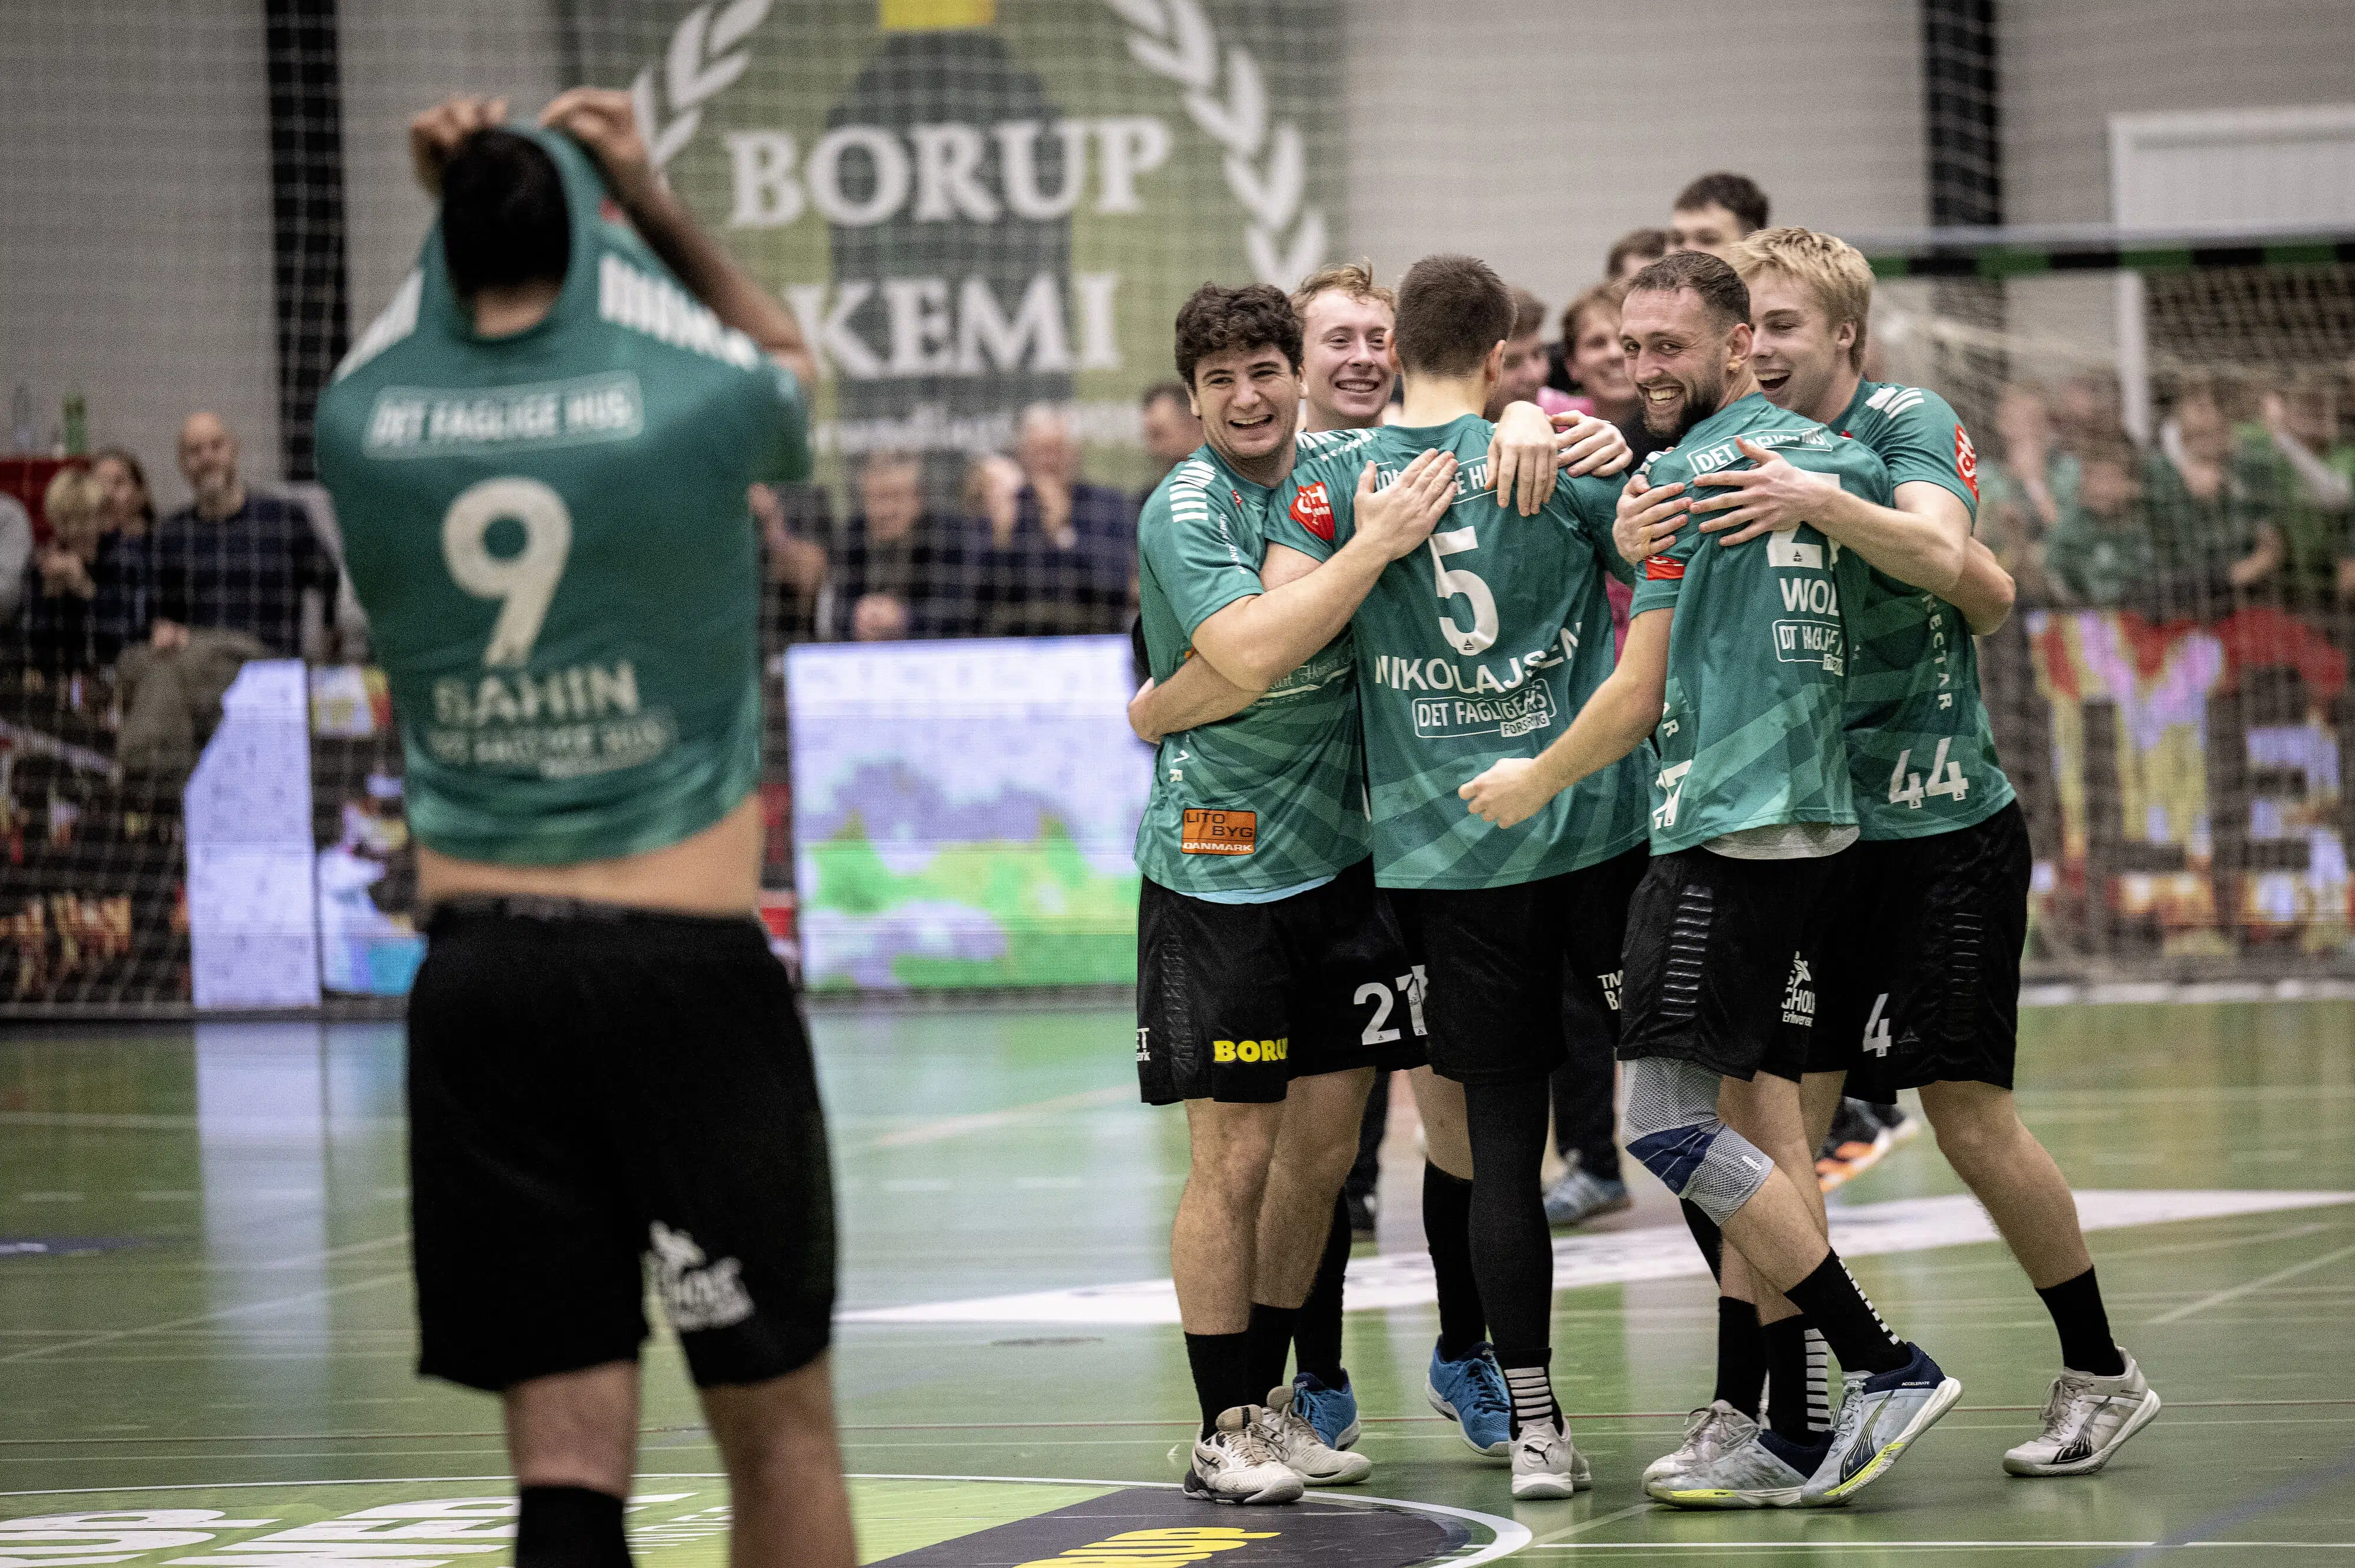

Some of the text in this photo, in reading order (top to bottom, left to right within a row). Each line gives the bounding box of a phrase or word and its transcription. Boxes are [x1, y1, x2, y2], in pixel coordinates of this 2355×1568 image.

[727, 119, 1172, 228] BORUP
[786, 271, 1122, 380] KEMI
[1694, 444, 1735, 471] DET
[443, 478, 572, 666] 9
[1428, 526, 1499, 656] 5
[1418, 703, 1448, 727] DET
[1888, 736, 1969, 809] 44
[1182, 842, 1253, 852] DANMARK
[1212, 825, 1253, 838] BYG
[1862, 993, 1892, 1058] 4
